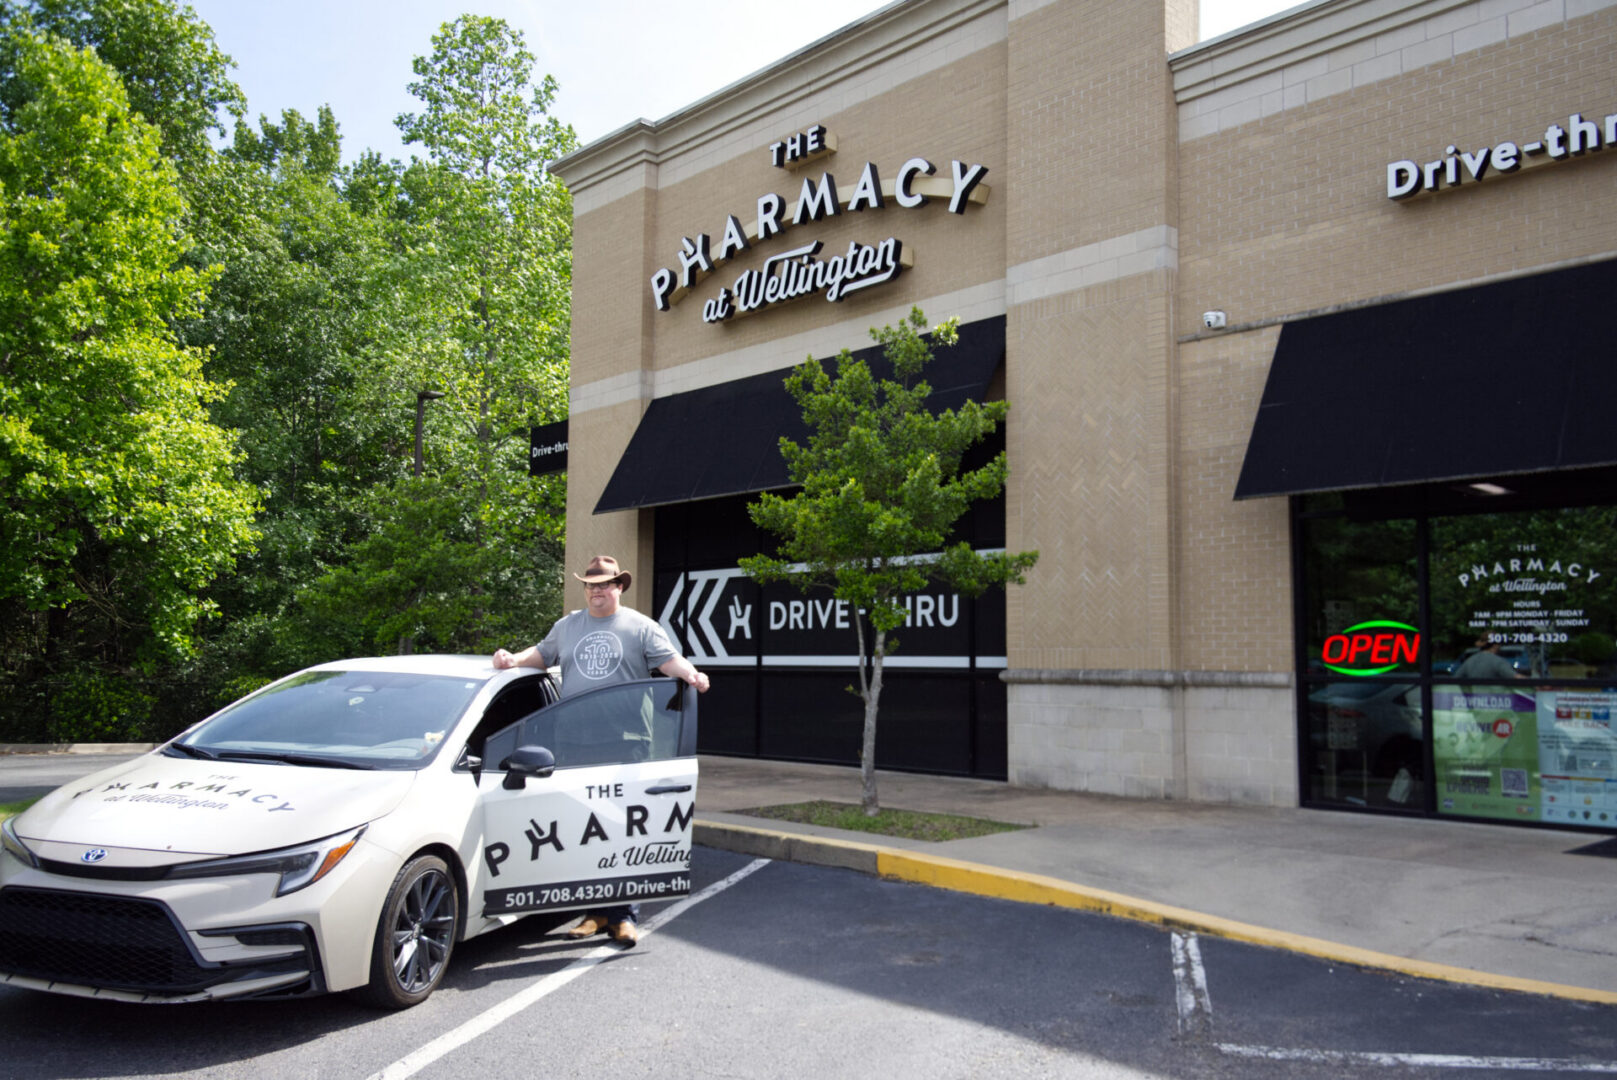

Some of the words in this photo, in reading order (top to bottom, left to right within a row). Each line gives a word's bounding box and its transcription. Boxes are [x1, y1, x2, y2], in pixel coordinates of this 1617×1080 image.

[769, 124, 825, 168] THE
[650, 157, 987, 311] PHARMACY
[702, 288, 732, 323] at
[733, 237, 902, 311] Wellington
[1517, 544, 1537, 552] THE
[1458, 557, 1601, 588] PHARMACY
[1489, 583, 1501, 593] at
[1502, 577, 1567, 595] Wellington
[1513, 610, 1549, 618] MONDAY
[1554, 609, 1584, 617] FRIDAY
[1509, 619, 1550, 627] SATURDAY
[1555, 619, 1590, 627] SUNDAY
[1488, 633, 1568, 643] 501-708-4320
[1322, 633, 1421, 664] OPEN
[1453, 695, 1512, 708] DOWNLOAD
[72, 780, 296, 813] PHARMACY
[585, 783, 624, 799] THE
[129, 792, 229, 811] Wellington
[598, 853, 619, 869] at
[505, 883, 613, 907] 501.708.4320
